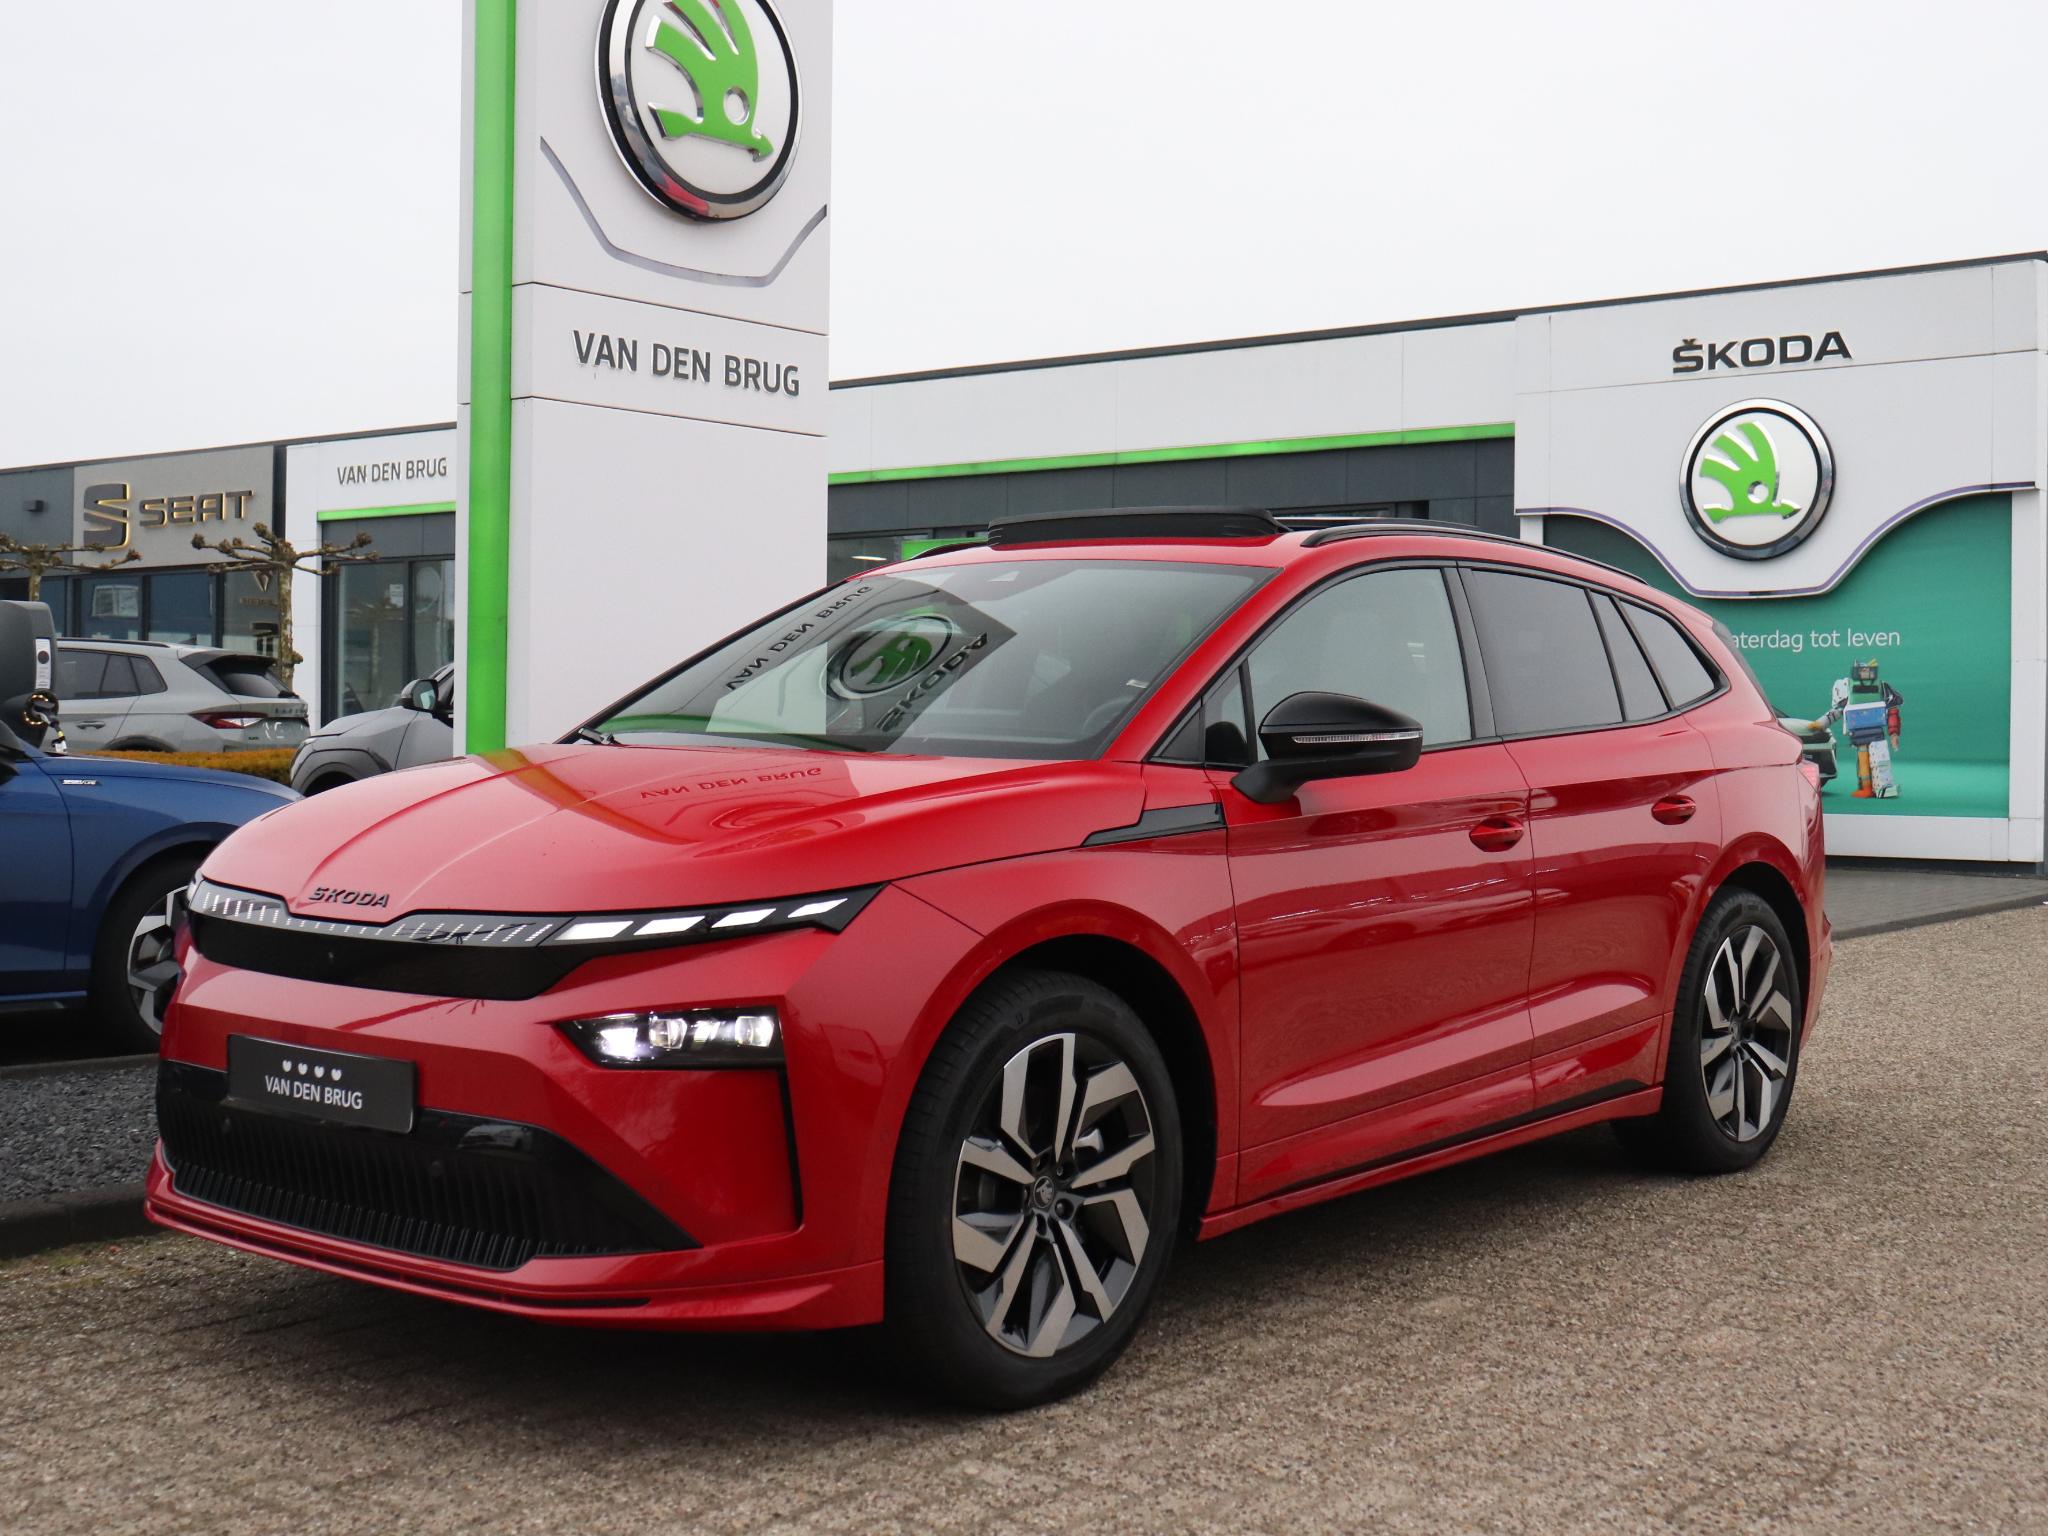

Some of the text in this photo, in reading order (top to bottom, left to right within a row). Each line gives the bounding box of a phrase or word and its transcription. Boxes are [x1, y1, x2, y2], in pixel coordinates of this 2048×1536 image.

[573, 329, 799, 397] VAN DEN BRUG
[1673, 331, 1852, 374] ŠKODA
[337, 457, 447, 485] VAN DEN BRUG
[139, 490, 254, 528] SEAT
[1732, 628, 1900, 653] aterdag tot leven
[265, 1075, 363, 1110] VAN DEN BRUG
